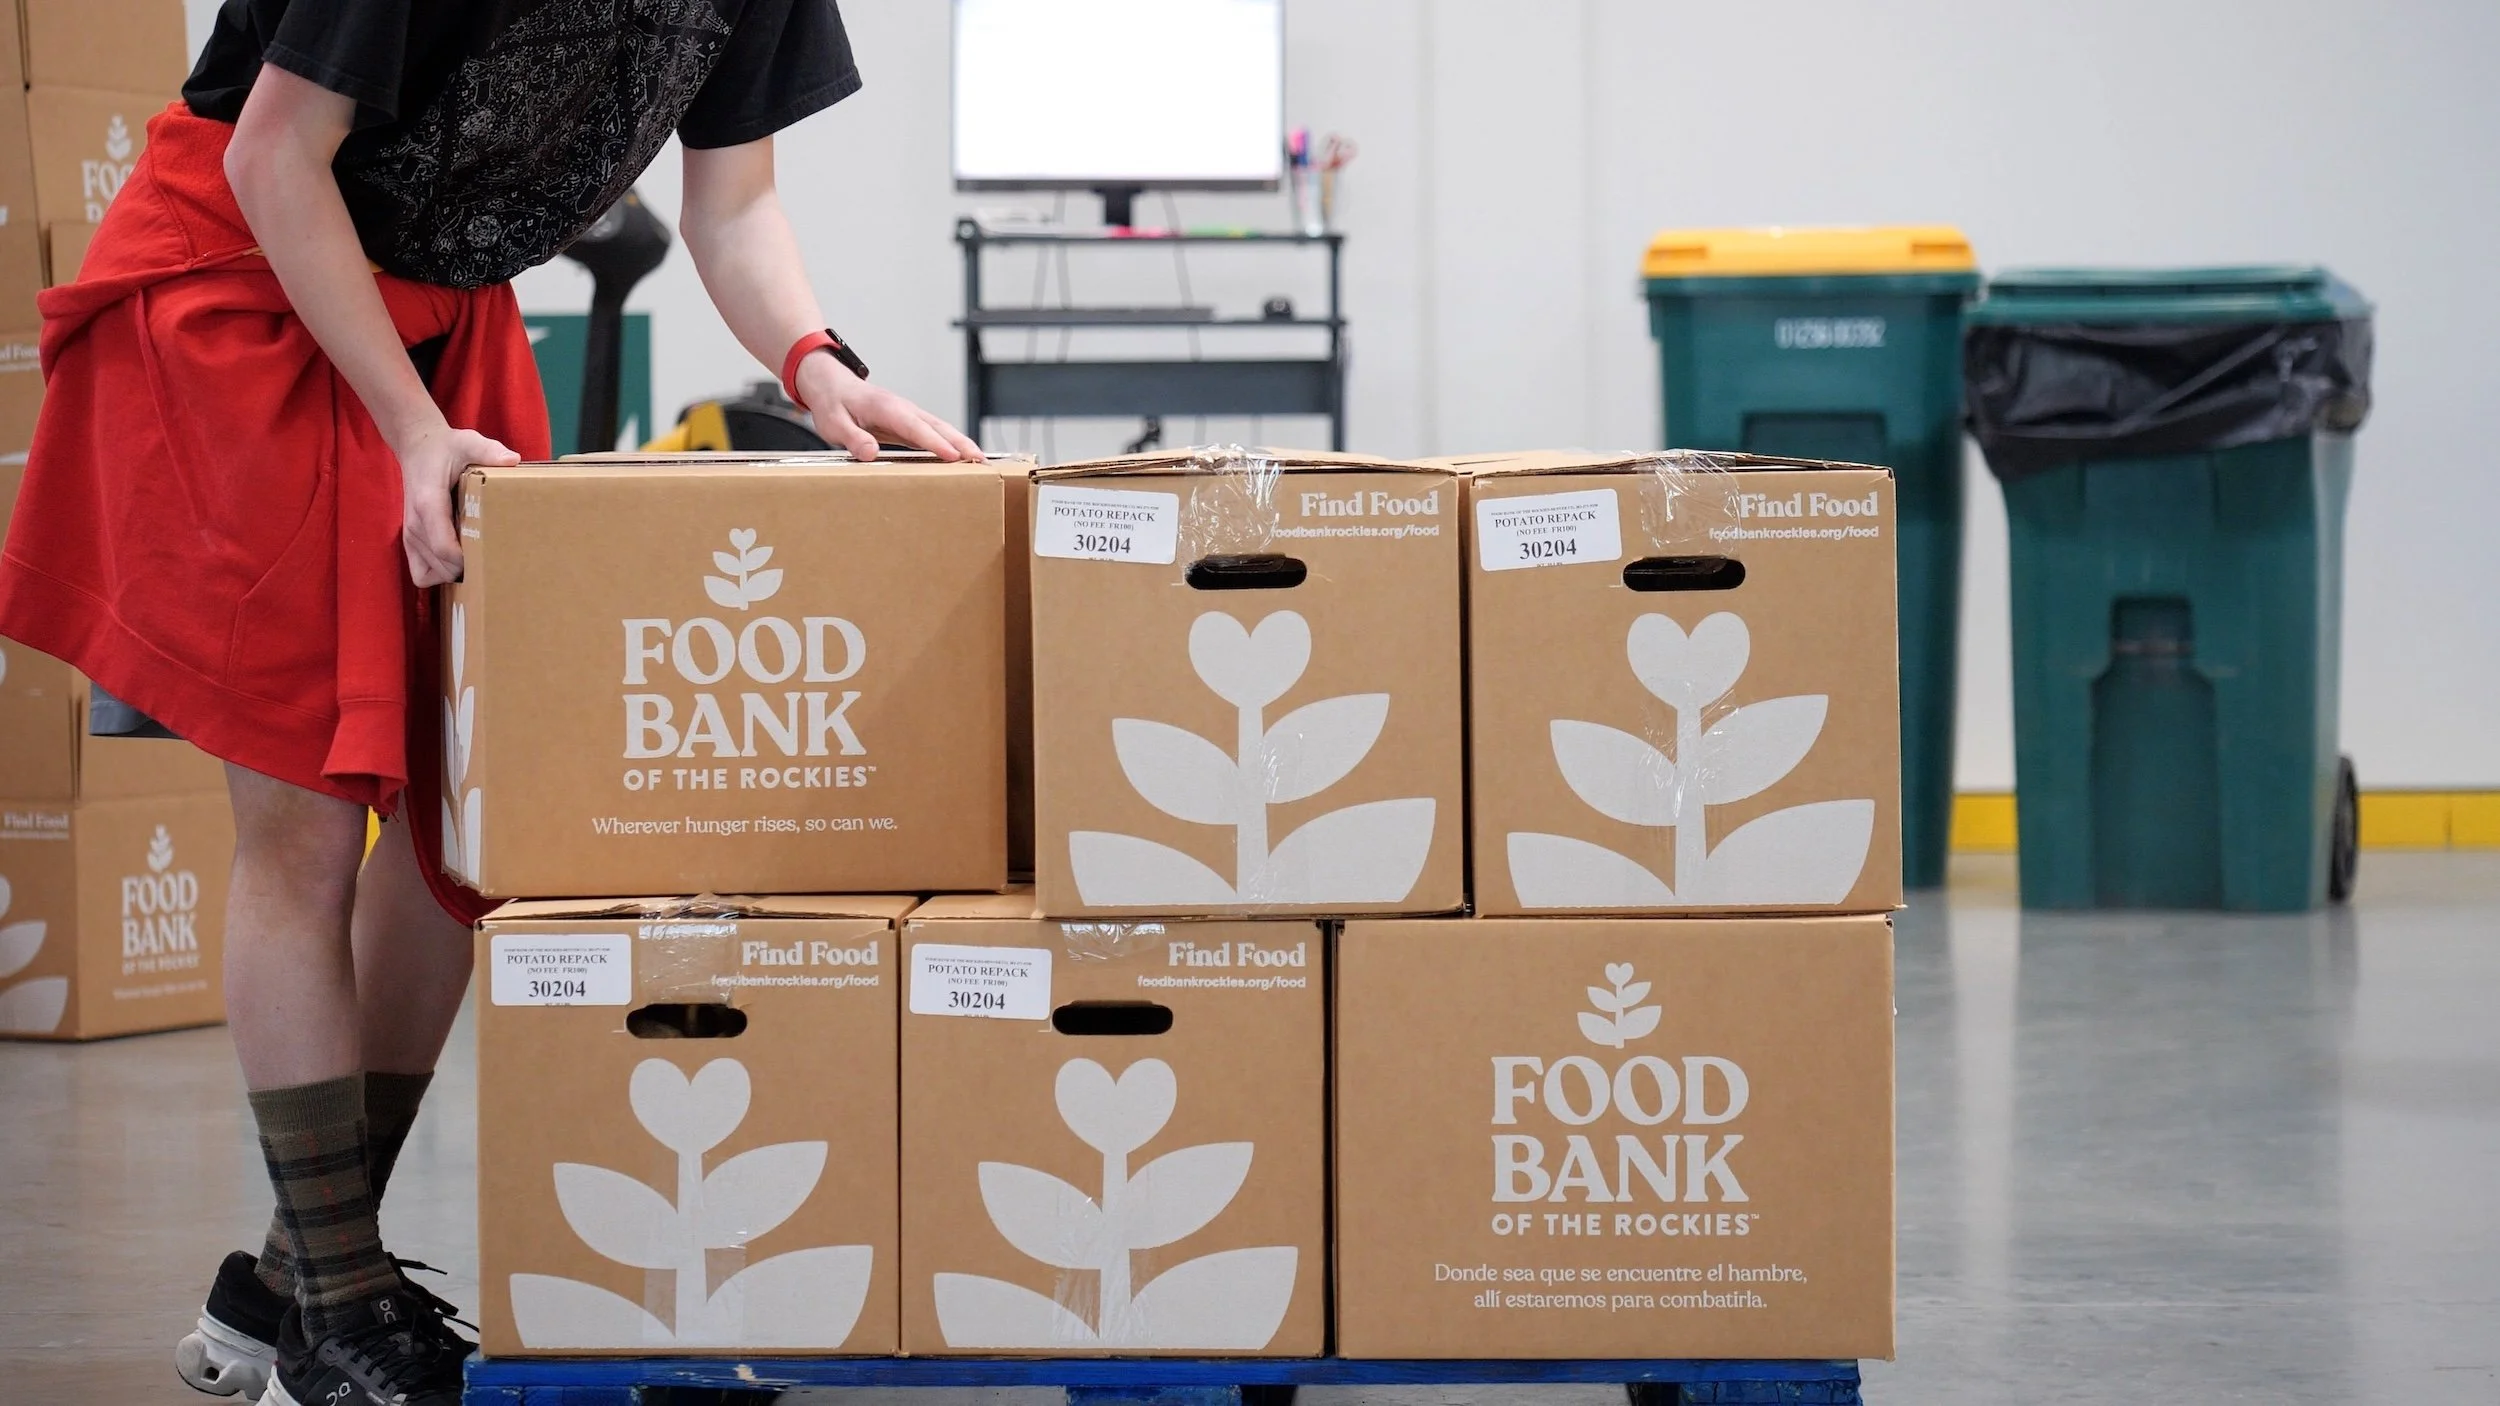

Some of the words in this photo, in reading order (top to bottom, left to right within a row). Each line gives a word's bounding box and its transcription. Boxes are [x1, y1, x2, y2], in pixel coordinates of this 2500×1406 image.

[81, 159, 134, 201] FO
[1054, 506, 1104, 519] POTATO
[1106, 510, 1156, 522] REPACK
[1301, 491, 1364, 517] Find
[1370, 491, 1439, 517] Food
[1739, 491, 1805, 518] Find
[1809, 491, 1879, 517] Food
[1073, 521, 1088, 529] (NO
[1495, 515, 1544, 528] POTATO
[1548, 510, 1596, 524] REPACK
[1271, 525, 1439, 539] foodbankrockies.org/food
[1516, 528, 1531, 537] (NO
[1533, 527, 1548, 535] FEE
[1552, 526, 1577, 534] FR100)
[1709, 526, 1879, 540] foodbankrockies.org/food
[1073, 534, 1131, 553] 30204
[1520, 538, 1577, 560] 30204
[622, 617, 866, 684] FOOD
[622, 691, 867, 758] BANK
[623, 769, 662, 791] OF
[673, 768, 727, 790] THE
[36, 813, 69, 829] Food
[592, 818, 680, 835] Wherever
[686, 817, 750, 837] hunger
[754, 817, 801, 835] rises,
[805, 819, 826, 831] so
[831, 818, 864, 831] can
[869, 817, 898, 831] we.
[122, 871, 198, 916] FOOD
[122, 911, 198, 958] BANK
[507, 955, 556, 964] POTATO
[559, 955, 607, 964] REPACK
[742, 941, 805, 966] Find
[810, 941, 879, 966] Food
[1169, 942, 1232, 968] Find
[1237, 942, 1306, 968] Food
[711, 974, 879, 989] foodbankrockies.org/food
[928, 964, 977, 975] POTATO
[980, 967, 1029, 978] REPACK
[528, 981, 586, 997] 30204
[1137, 975, 1306, 990] foodbankrockies.org/food
[948, 991, 1006, 1010] 30204
[1491, 1055, 1749, 1125] FOOD
[1491, 1134, 1749, 1202] BANK
[1491, 1214, 1533, 1235] OF
[1544, 1214, 1601, 1235] THE
[1435, 1264, 1497, 1281] Donde
[1503, 1268, 1535, 1281] sea
[1540, 1268, 1576, 1286] que
[1581, 1268, 1602, 1281] se
[1606, 1266, 1702, 1281] encuentre
[1707, 1264, 1723, 1281] el
[1728, 1264, 1807, 1284] hambre,
[1474, 1290, 1500, 1308] allí
[1506, 1292, 1606, 1308] estaremos
[1612, 1294, 1655, 1312] para
[1659, 1290, 1767, 1308] combatirla.
